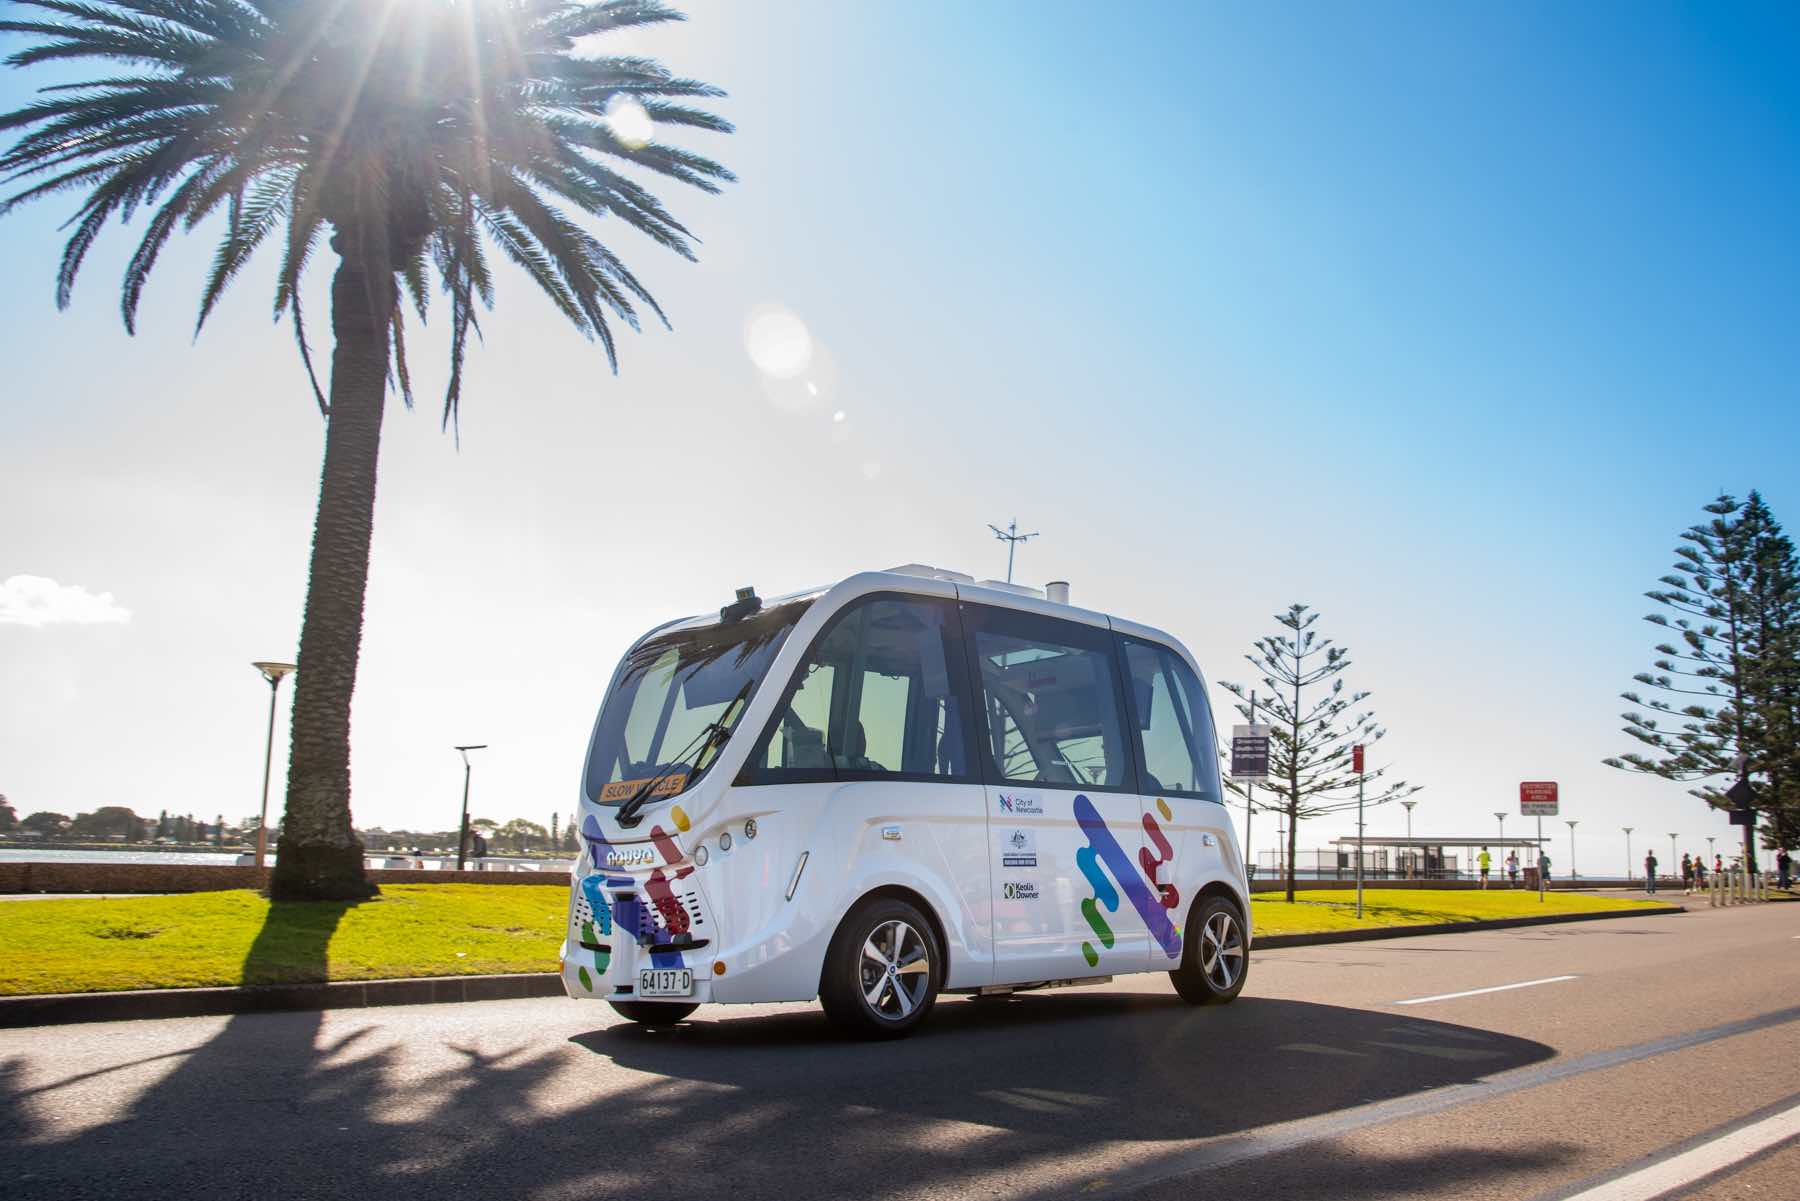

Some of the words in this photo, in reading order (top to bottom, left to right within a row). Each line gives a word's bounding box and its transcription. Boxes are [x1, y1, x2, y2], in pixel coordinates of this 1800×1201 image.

[606, 783, 633, 798] SLOW
[1015, 882, 1034, 891] Keolis
[1015, 890, 1040, 899] Downer
